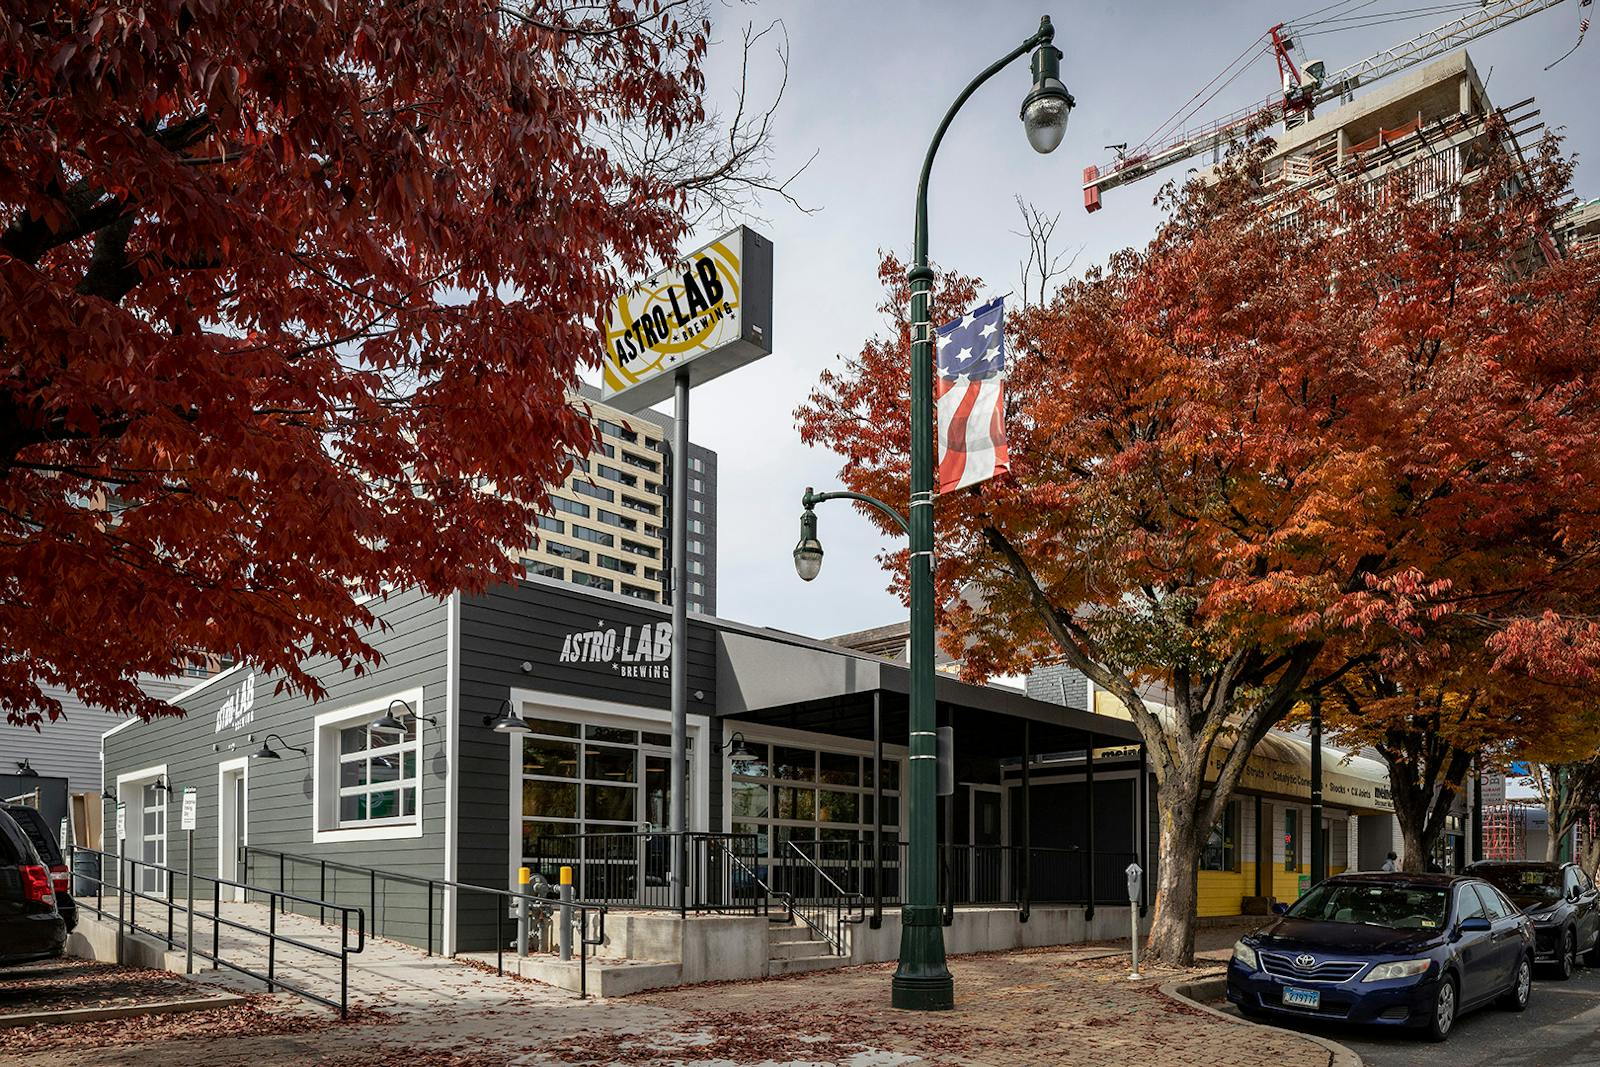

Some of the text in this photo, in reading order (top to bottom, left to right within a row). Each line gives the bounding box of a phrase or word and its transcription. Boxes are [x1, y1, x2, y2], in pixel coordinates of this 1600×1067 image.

[615, 257, 724, 367] ASTRO LAB
[683, 301, 732, 341] BREWING
[560, 622, 673, 662] ASTRO LAB
[621, 665, 669, 678] BREWING
[235, 672, 255, 719] LAB
